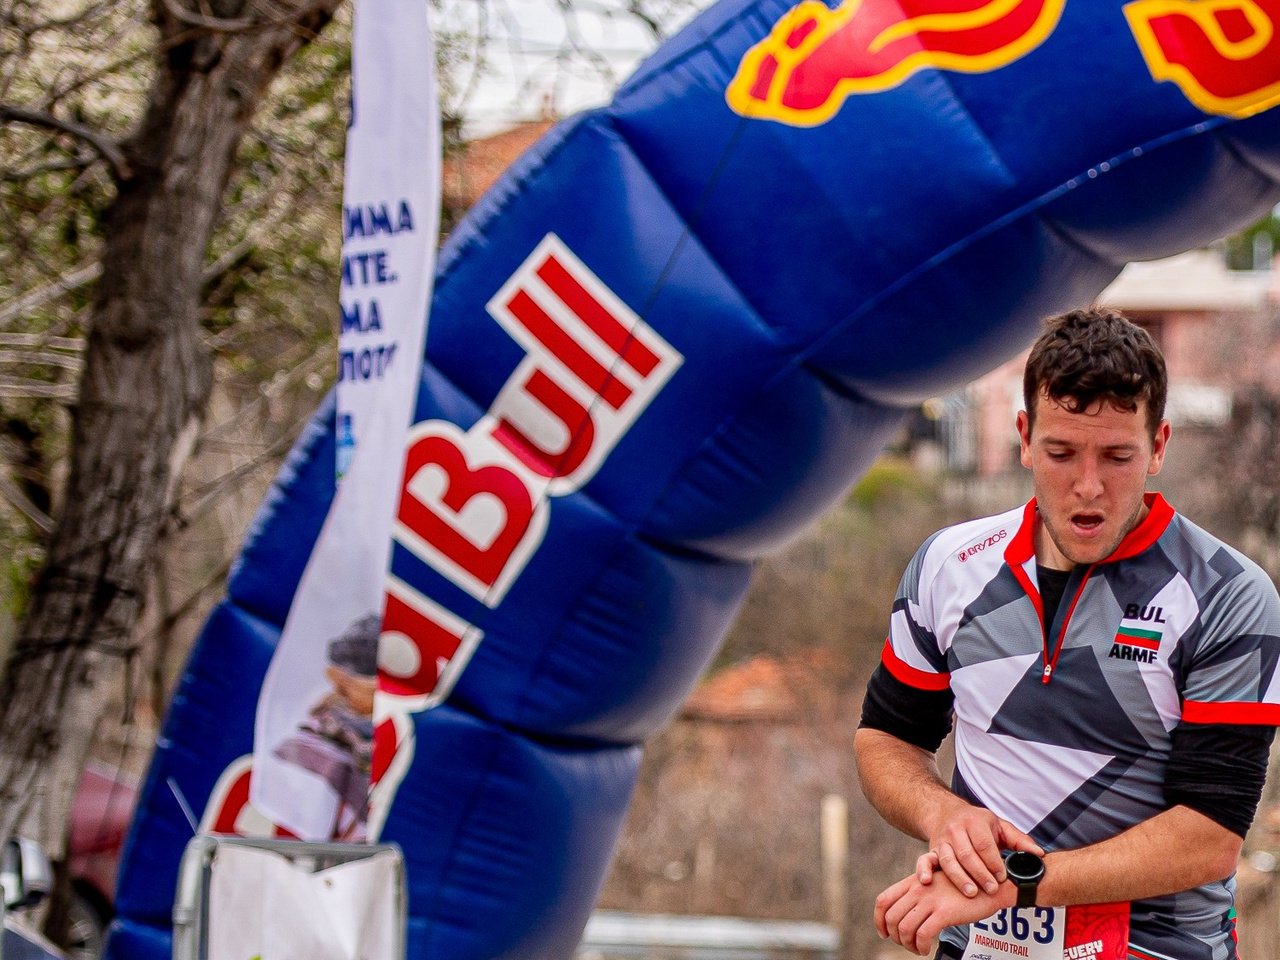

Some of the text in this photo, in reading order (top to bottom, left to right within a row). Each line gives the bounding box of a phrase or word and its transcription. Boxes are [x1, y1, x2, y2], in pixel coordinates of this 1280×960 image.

[396, 252, 662, 588] Bull
[967, 529, 1008, 556] BRYZOS
[1123, 603, 1166, 624] BUL
[1108, 643, 1158, 664] ARMF
[974, 934, 1029, 958] MARKOVO TRAIL
